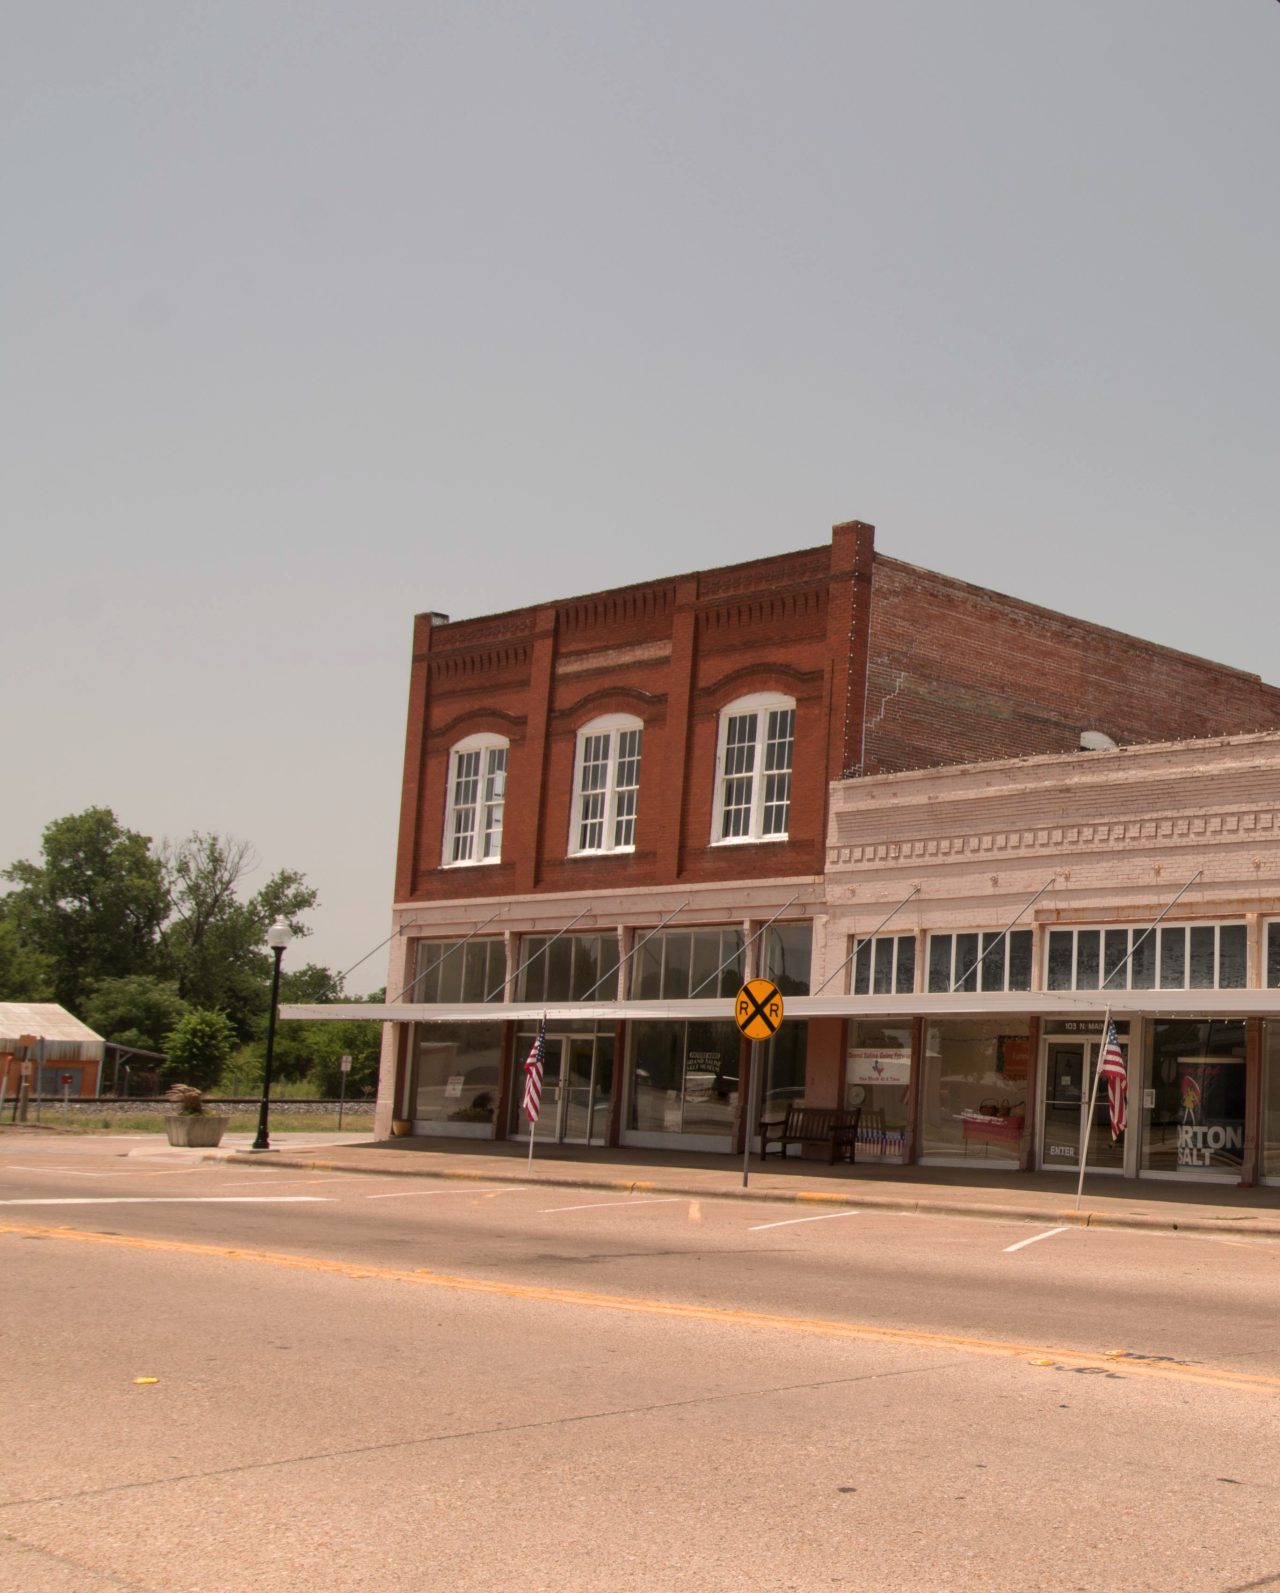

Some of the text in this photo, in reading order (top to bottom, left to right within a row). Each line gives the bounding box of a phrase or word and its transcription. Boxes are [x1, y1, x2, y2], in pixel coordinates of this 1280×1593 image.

[739, 1000, 779, 1018] R R
[1065, 1022, 1077, 1030] 103
[1050, 1145, 1075, 1157] ENTER
[1177, 1148, 1215, 1166] SALT
